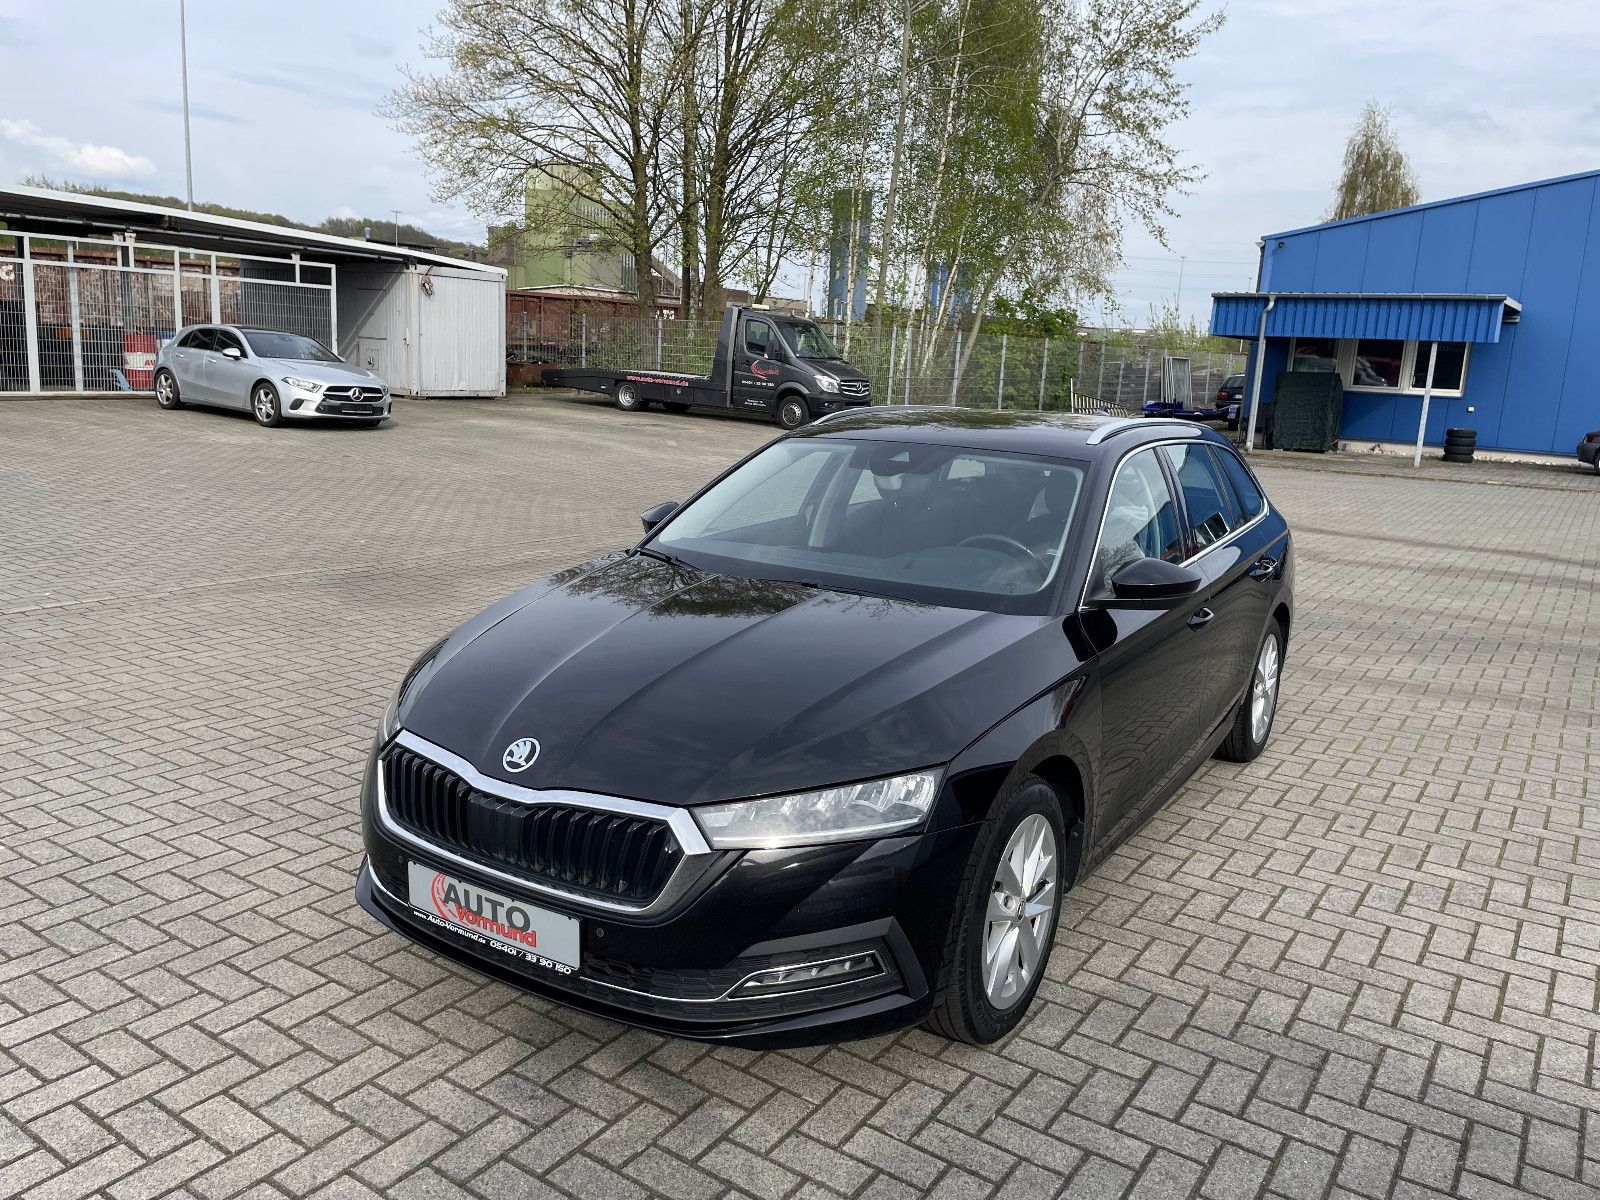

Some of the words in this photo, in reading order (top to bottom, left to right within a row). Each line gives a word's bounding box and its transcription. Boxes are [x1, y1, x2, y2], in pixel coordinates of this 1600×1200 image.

[443, 882, 531, 933] AUTO
[454, 903, 537, 948] Vormund
[489, 939, 517, 956] 05401
[524, 952, 537, 964] 33
[539, 956, 552, 968] 90
[555, 961, 572, 975] 150
